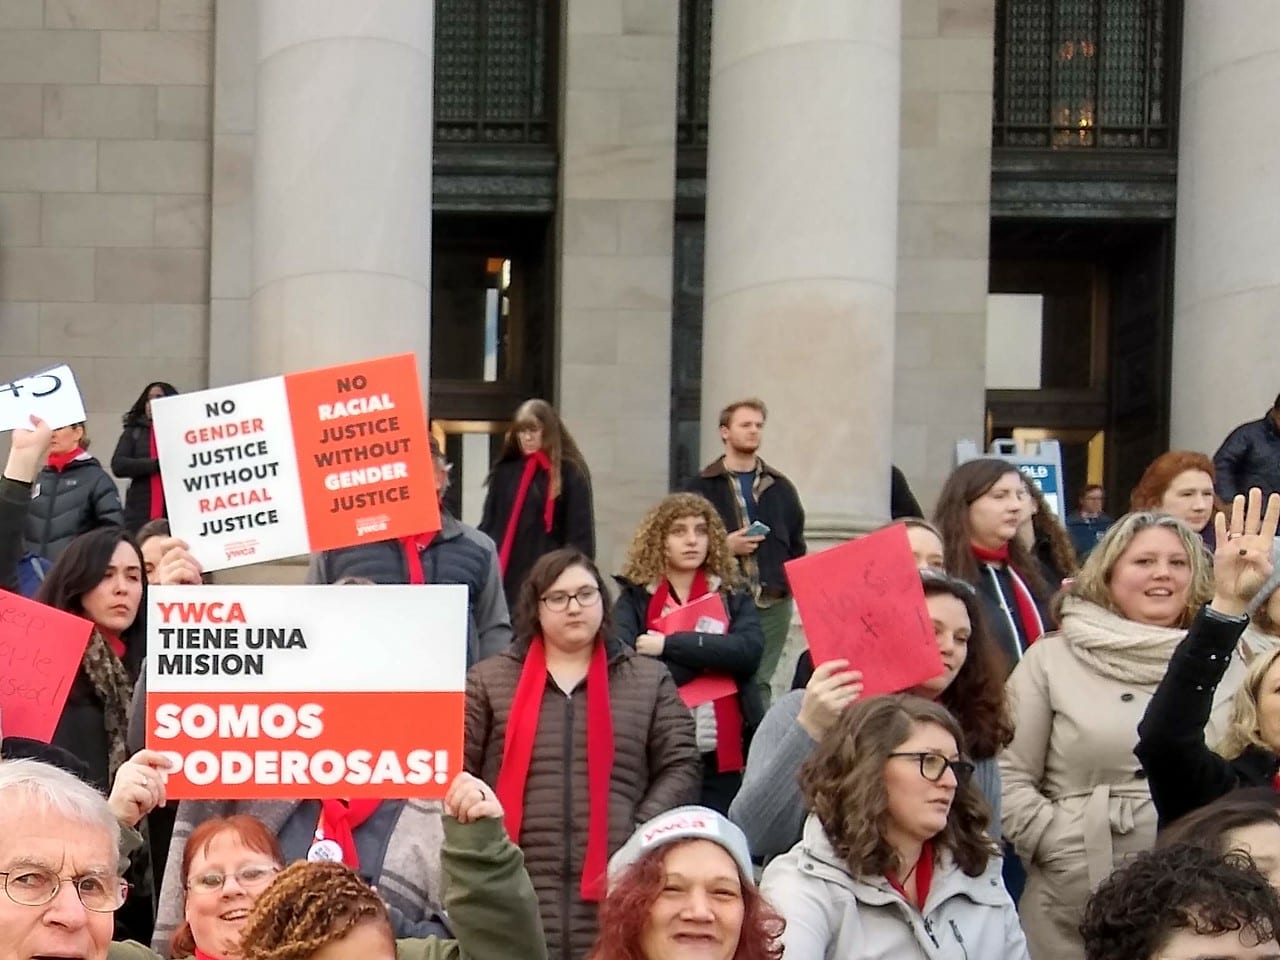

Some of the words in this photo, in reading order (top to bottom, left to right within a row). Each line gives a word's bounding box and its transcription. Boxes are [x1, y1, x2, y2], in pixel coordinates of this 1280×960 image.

[337, 375, 367, 393] NO
[205, 399, 236, 418] NO
[318, 393, 394, 421] RACIAL
[184, 418, 264, 445] GENDER
[319, 416, 400, 444] JUSTICE
[188, 440, 268, 468] JUSTICE
[313, 438, 411, 468] WITHOUT
[183, 462, 279, 493] WITHOUT
[324, 461, 408, 491] GENDER
[198, 487, 272, 513] RACIAL
[330, 486, 410, 513] JUSTICE
[199, 509, 278, 536] JUSTICE
[357, 523, 387, 536] ywca
[225, 547, 256, 560] ywca
[157, 602, 246, 623] YWCA
[158, 628, 238, 649] TIENE
[246, 628, 307, 649] UNA
[157, 654, 264, 675] MISION
[154, 703, 324, 739] SOMOS
[160, 750, 449, 785] PODEROSAS!
